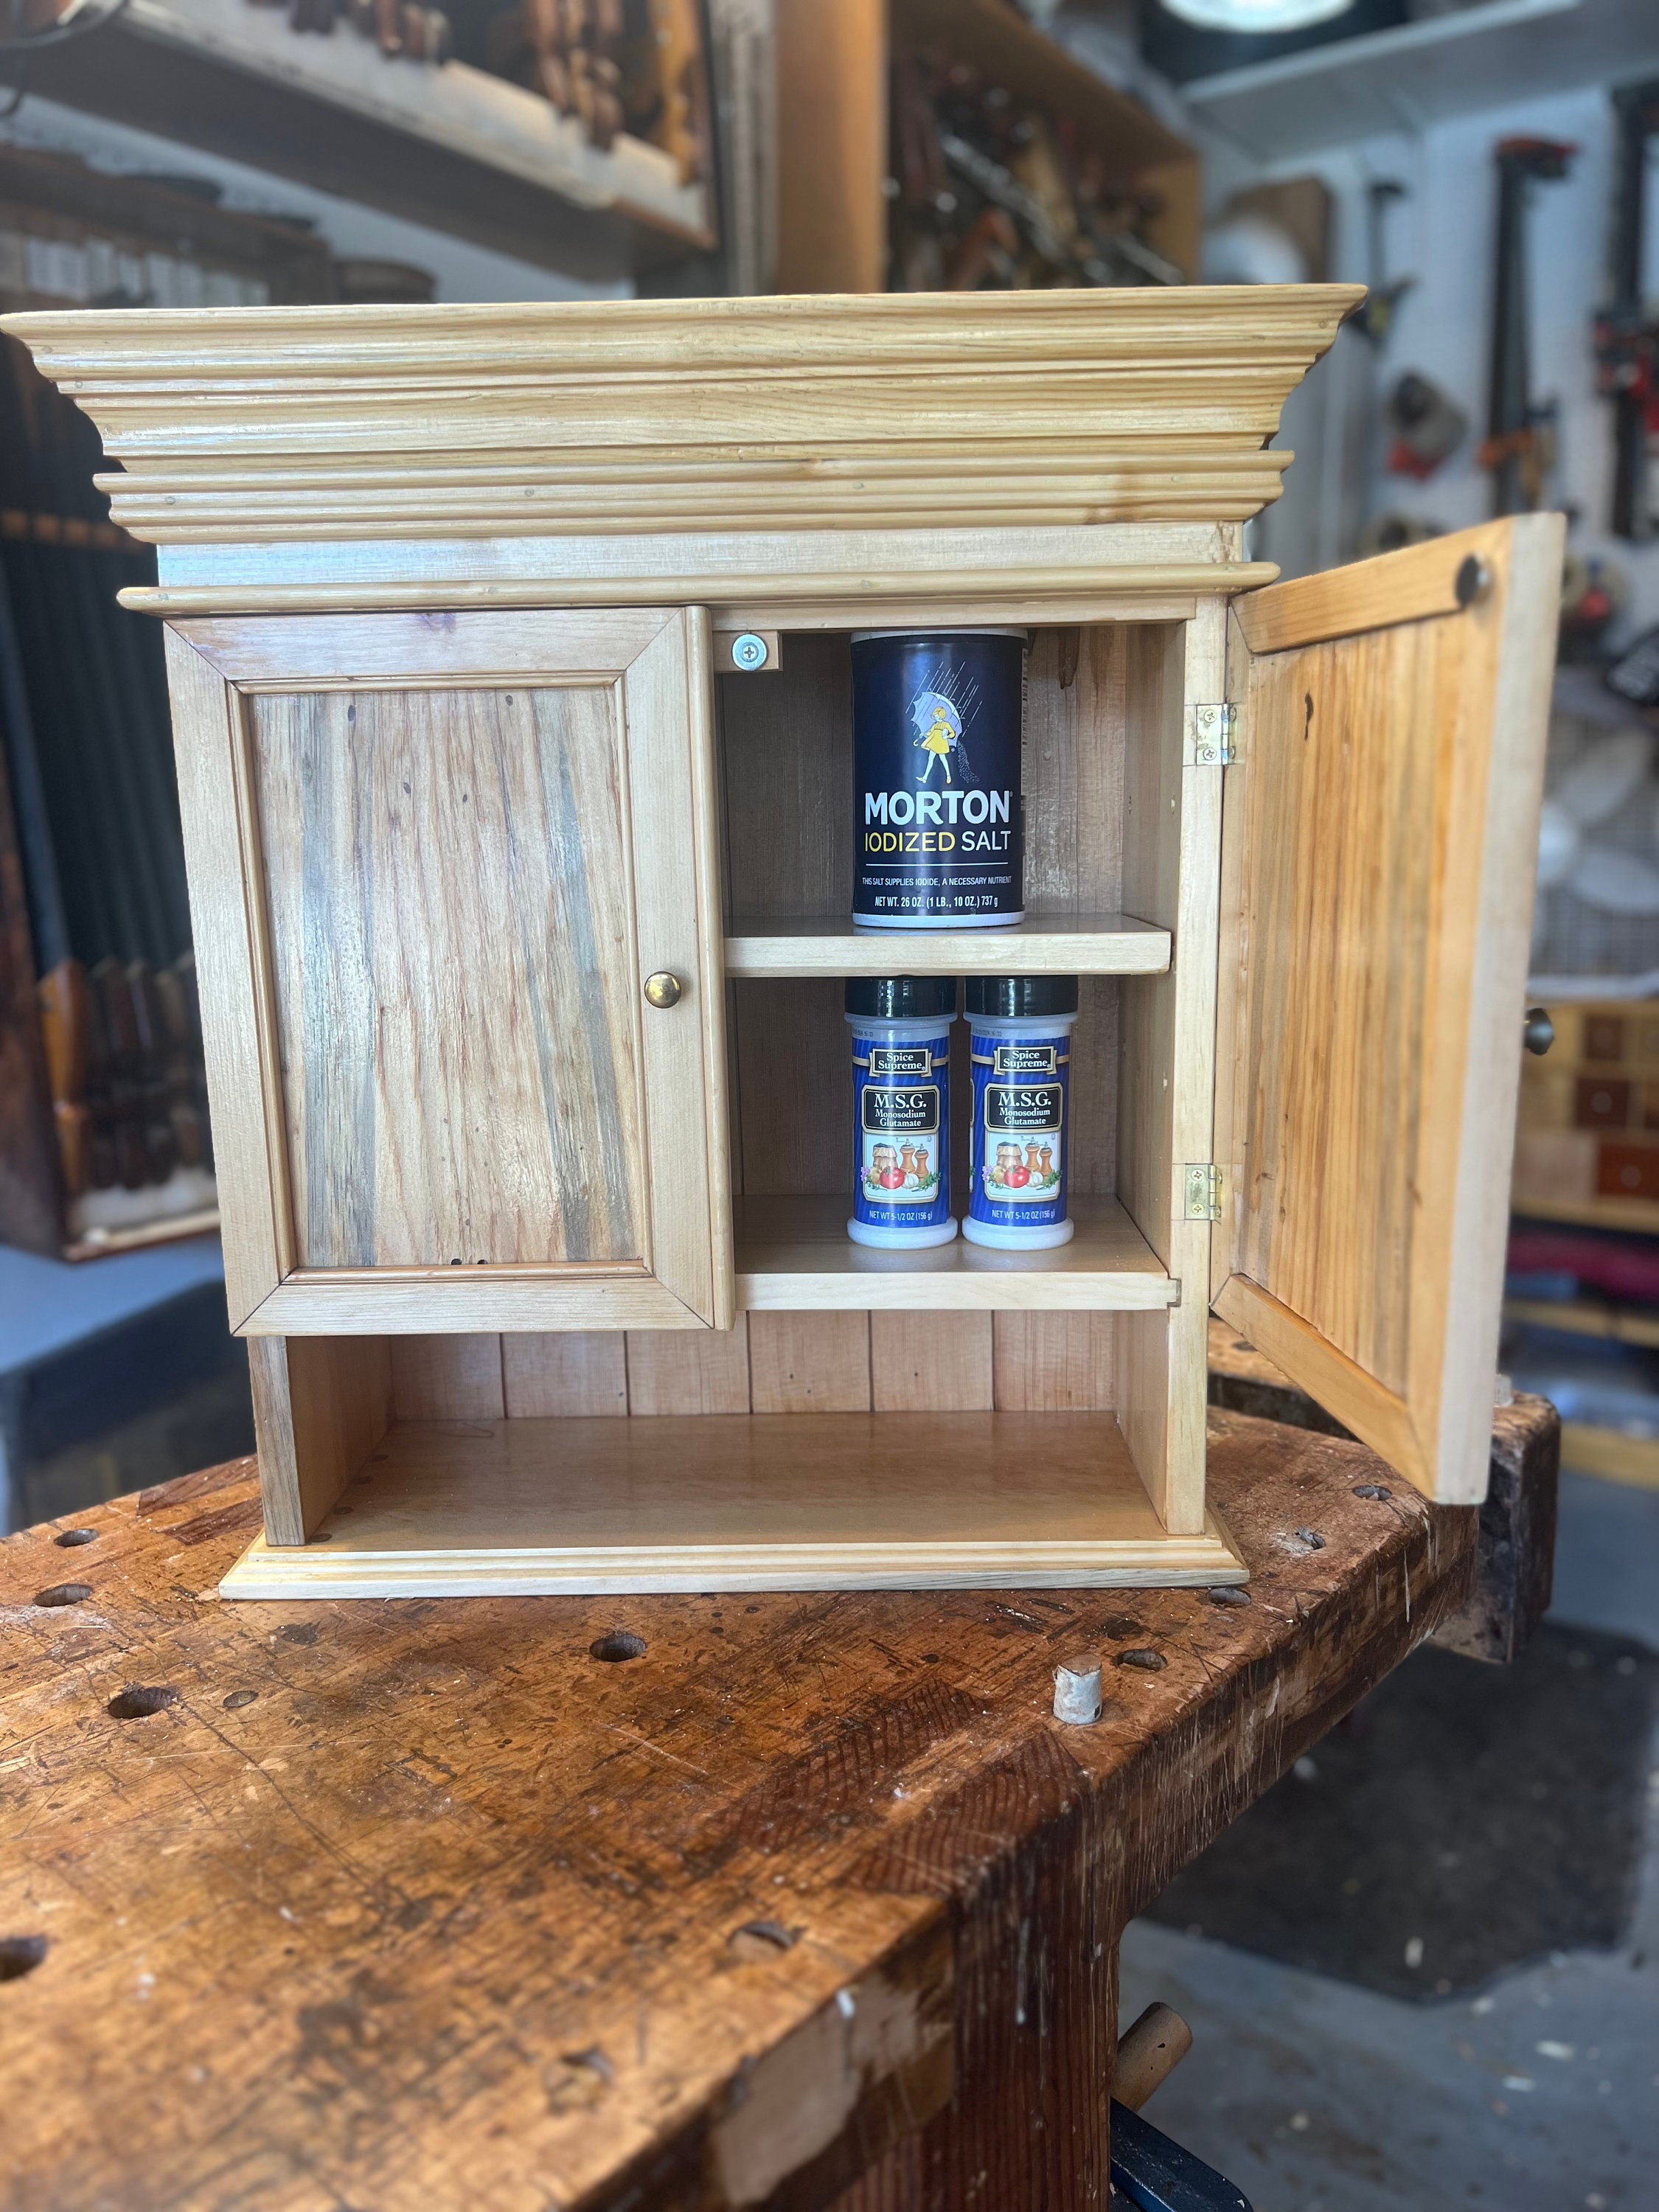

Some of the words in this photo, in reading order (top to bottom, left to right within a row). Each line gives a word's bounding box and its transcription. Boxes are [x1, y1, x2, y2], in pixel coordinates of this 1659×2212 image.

[865, 790, 1009, 825] MORTON
[865, 832, 956, 852] IODIZED
[961, 830, 1011, 852] SALT
[885, 878, 914, 886] SUPPLIES
[915, 878, 940, 886] IODIDE,
[949, 877, 987, 886] NECESSARY
[988, 875, 1012, 884] NUTRIENT
[874, 896, 886, 907] NET
[887, 897, 899, 907] WT.
[901, 897, 910, 907] 26
[911, 897, 924, 907] OZ.
[926, 897, 933, 909] (1
[936, 897, 952, 908] LB.,
[953, 897, 963, 907] 10
[964, 896, 979, 908] OZ.)
[981, 895, 993, 906] 737
[994, 897, 998, 908] g
[886, 1053, 914, 1062] Spice
[1012, 1051, 1040, 1060] Spice
[878, 1060, 922, 1071] Supreme
[1003, 1058, 1048, 1068] Supreme
[874, 1093, 927, 1108] M.S.G.
[998, 1091, 1051, 1107] M.S.G.
[874, 1109, 926, 1119] Monosodium
[999, 1107, 1051, 1117] Monosodium
[880, 1118, 922, 1127] Glutamate
[1004, 1116, 1046, 1126] Glutamate
[869, 1210, 880, 1219] NET
[880, 1211, 890, 1220] WT
[891, 1212, 905, 1221] 5-1/2
[906, 1212, 914, 1221] OZ
[915, 1211, 927, 1221] (156
[927, 1211, 933, 1220] g)
[992, 1209, 1003, 1218] NET
[1004, 1211, 1015, 1219] WT
[1015, 1211, 1030, 1220] 5-1/2
[1031, 1211, 1039, 1219] OZ
[1040, 1210, 1050, 1219] (156
